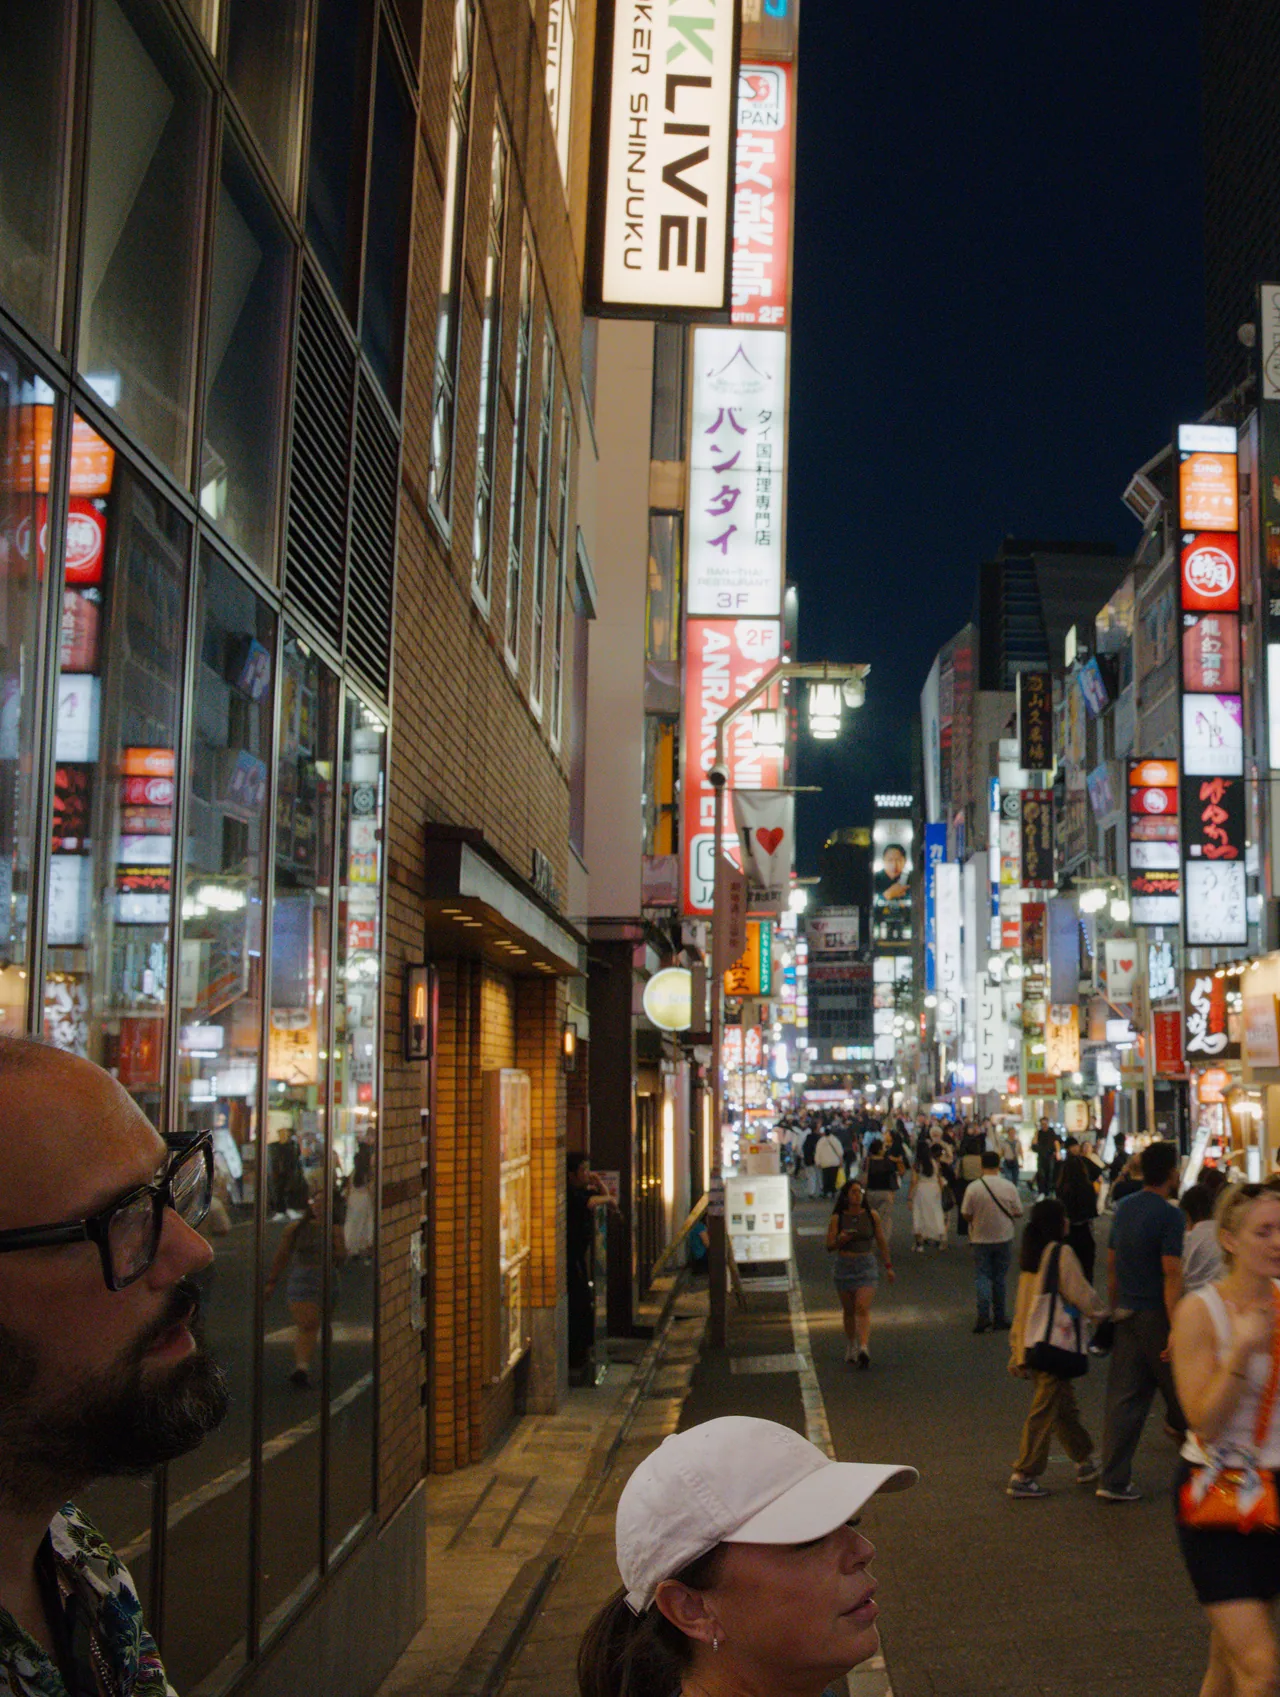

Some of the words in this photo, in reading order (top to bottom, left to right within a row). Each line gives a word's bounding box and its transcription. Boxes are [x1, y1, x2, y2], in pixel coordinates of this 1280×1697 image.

[623, 93, 649, 270] SHINJUKU
[659, 0, 715, 273] KLIVE
[758, 305, 784, 323] 2F
[705, 407, 748, 555] バンタイ
[755, 409, 773, 546] タイ国料理専門店
[716, 592, 749, 609] 3F
[746, 629, 773, 646] 2F
